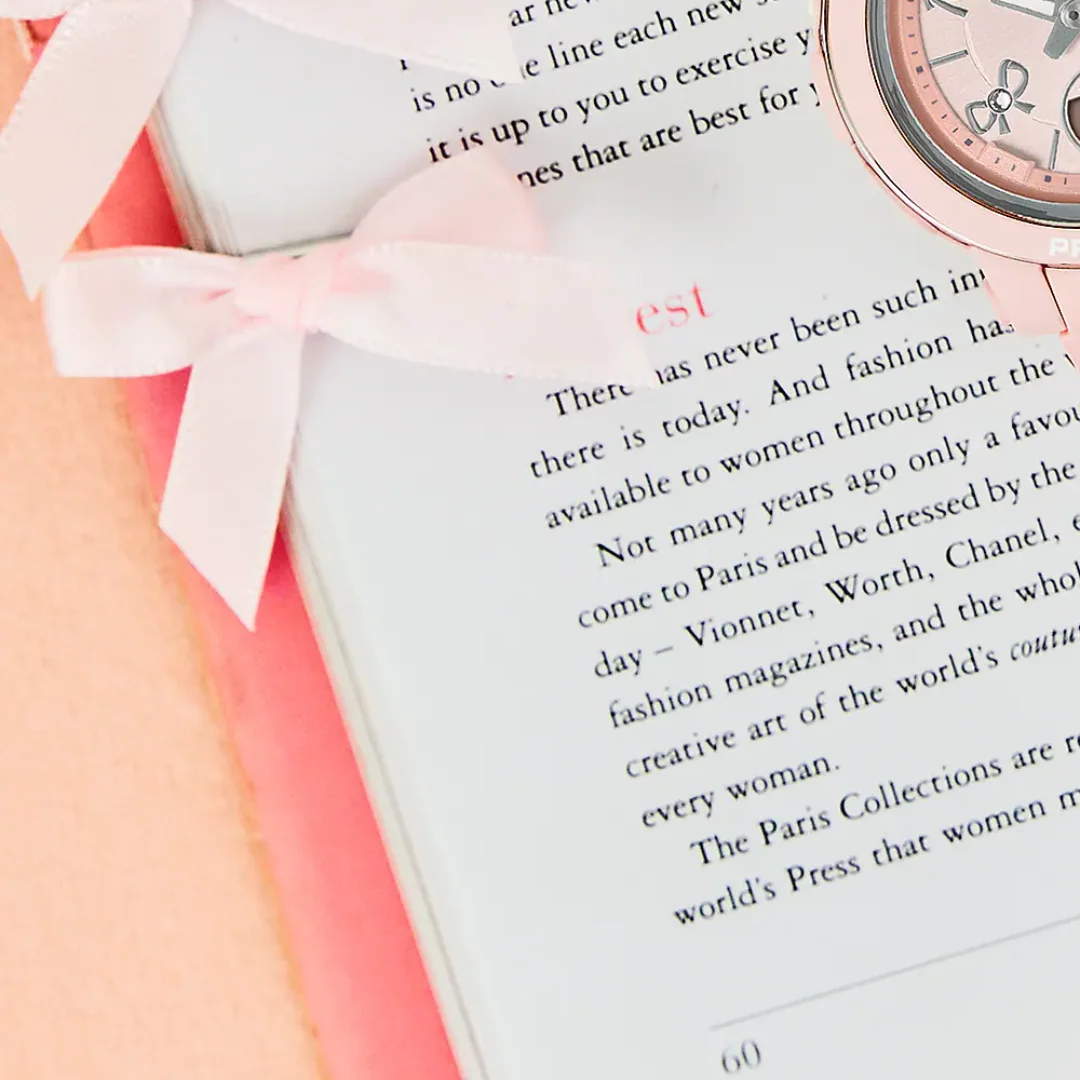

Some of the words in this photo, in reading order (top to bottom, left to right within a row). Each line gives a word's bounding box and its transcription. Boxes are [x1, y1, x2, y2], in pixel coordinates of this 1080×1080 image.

[426, 137, 452, 164] it
[458, 127, 484, 152] is
[490, 118, 530, 146] up
[538, 106, 568, 128] to
[575, 86, 630, 125] you
[637, 74, 668, 98] to
[675, 36, 788, 86] exercise
[530, 442, 605, 479] there
[620, 425, 646, 451] is
[662, 399, 750, 438] today.
[770, 363, 830, 406] And
[846, 335, 954, 382] fashion
[578, 592, 652, 629] come
[660, 582, 690, 604] to
[694, 552, 769, 592] Paris
[774, 528, 828, 568] and
[830, 523, 868, 550] be
[875, 482, 981, 537] dressed
[984, 476, 1020, 506] by
[1030, 460, 1076, 490] the
[594, 648, 642, 678] day
[684, 600, 815, 647] Vionnet,
[824, 558, 935, 604] Worth,
[945, 516, 1060, 569] Chanel,
[608, 684, 713, 729] fashion
[724, 634, 884, 694] magazines,
[892, 602, 946, 642] and
[957, 592, 1004, 622] the
[626, 732, 736, 778] creative
[747, 714, 788, 742] art
[798, 690, 826, 725] of
[838, 684, 884, 713] the
[895, 645, 999, 694] world's
[641, 790, 714, 828] every
[726, 756, 840, 800] woman.
[689, 834, 749, 866] The
[758, 807, 832, 846] Paris
[839, 758, 1002, 820] Collections
[1011, 744, 1054, 770] are
[673, 876, 777, 926] world's
[786, 856, 861, 892] Press
[872, 835, 930, 867] that
[942, 800, 1047, 844] women
[721, 1042, 762, 1074] 60
